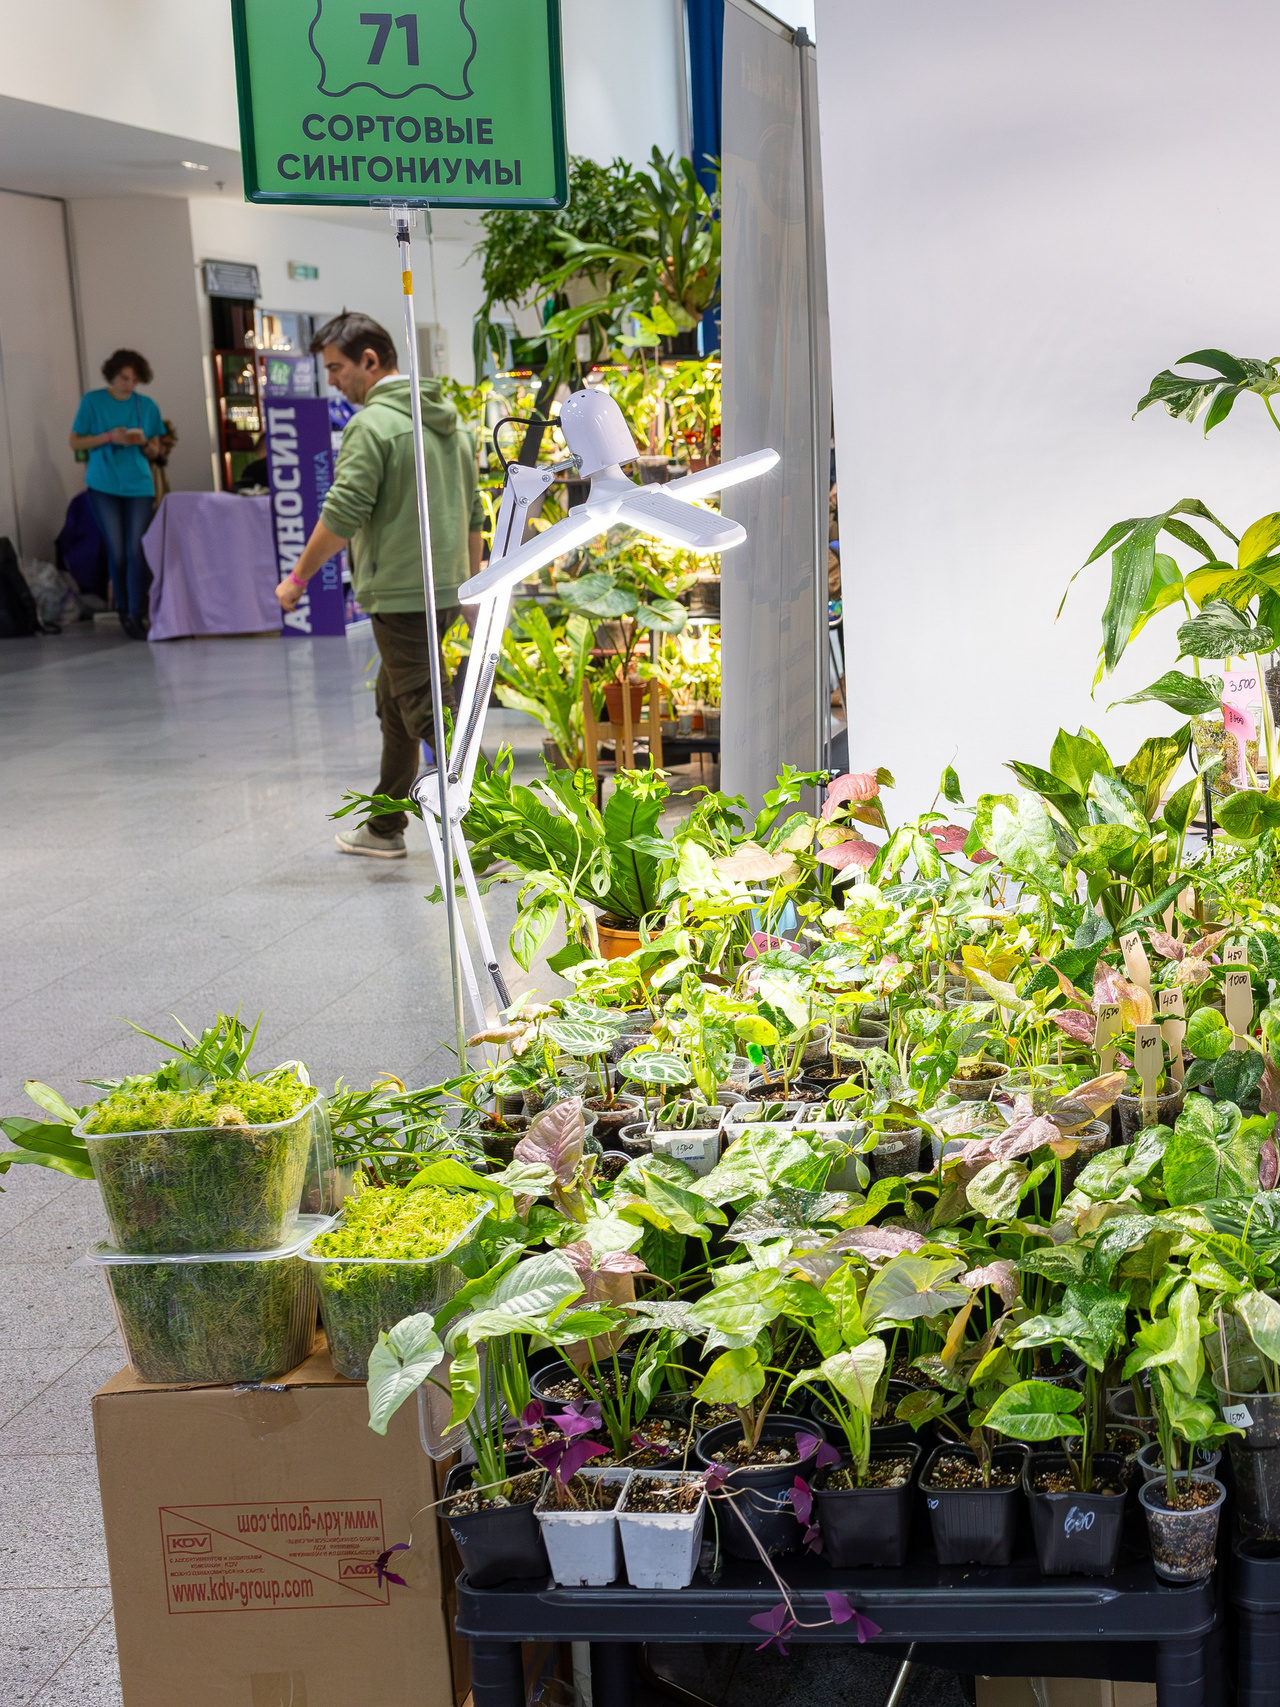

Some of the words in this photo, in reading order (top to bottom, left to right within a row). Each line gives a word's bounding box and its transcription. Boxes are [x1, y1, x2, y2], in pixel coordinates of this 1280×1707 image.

[360, 13, 419, 66] 71
[302, 114, 494, 145] СОРТОВЫЕ
[277, 153, 522, 186] СИНГОНИУМЫ
[268, 406, 313, 634] АИНОСИЛ
[1229, 678, 1257, 693] 3500
[1227, 950, 1243, 961] 450
[1228, 974, 1248, 986] 1000
[1162, 994, 1178, 1008] 450
[1230, 1412, 1246, 1424] 1500
[237, 1506, 379, 1536] www.kdv-group.com
[172, 1537, 208, 1548] KDV
[172, 1576, 314, 1607] www.kdv-group.com
